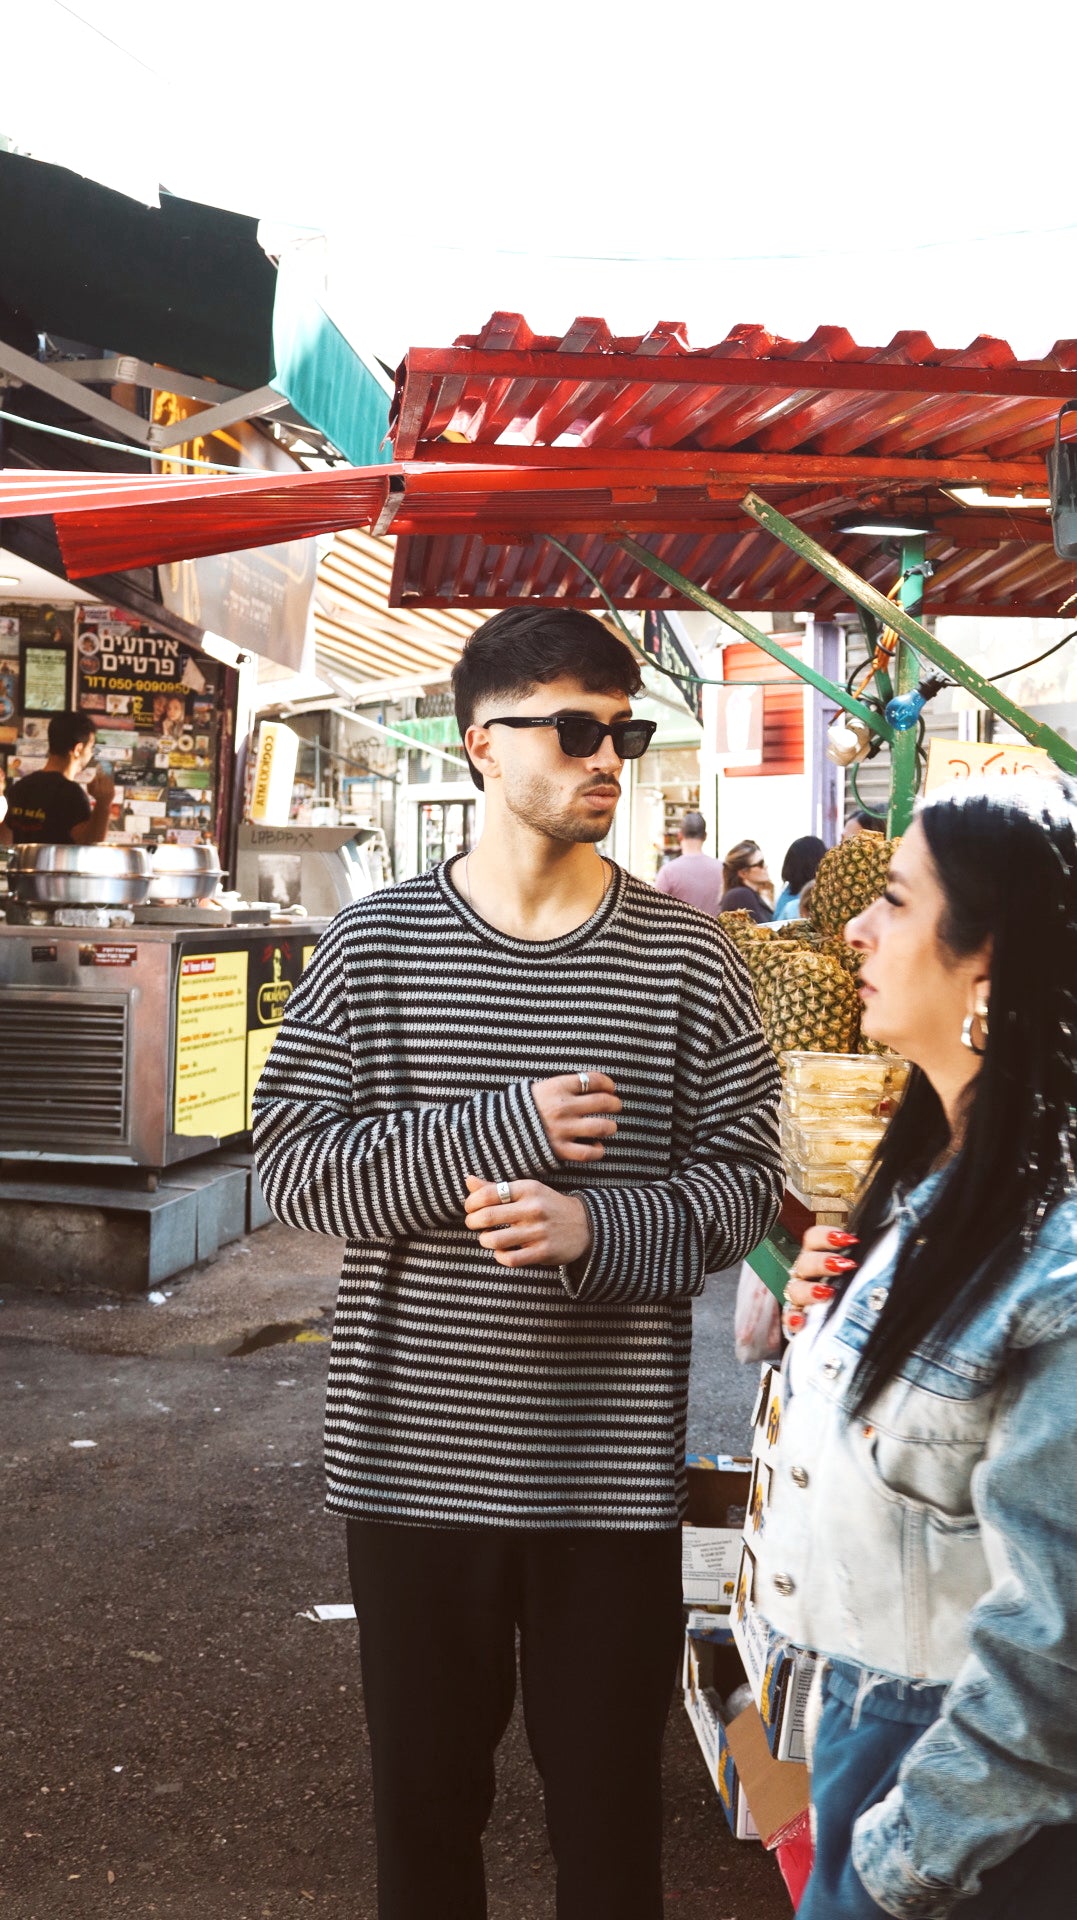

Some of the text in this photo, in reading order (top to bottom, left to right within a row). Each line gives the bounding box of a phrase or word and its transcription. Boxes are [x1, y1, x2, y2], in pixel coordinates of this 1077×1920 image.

[102, 634, 179, 657] אירועים
[102, 654, 175, 676] פרטיים
[108, 677, 191, 694] 050-9090950
[256, 783, 268, 806] ATM
